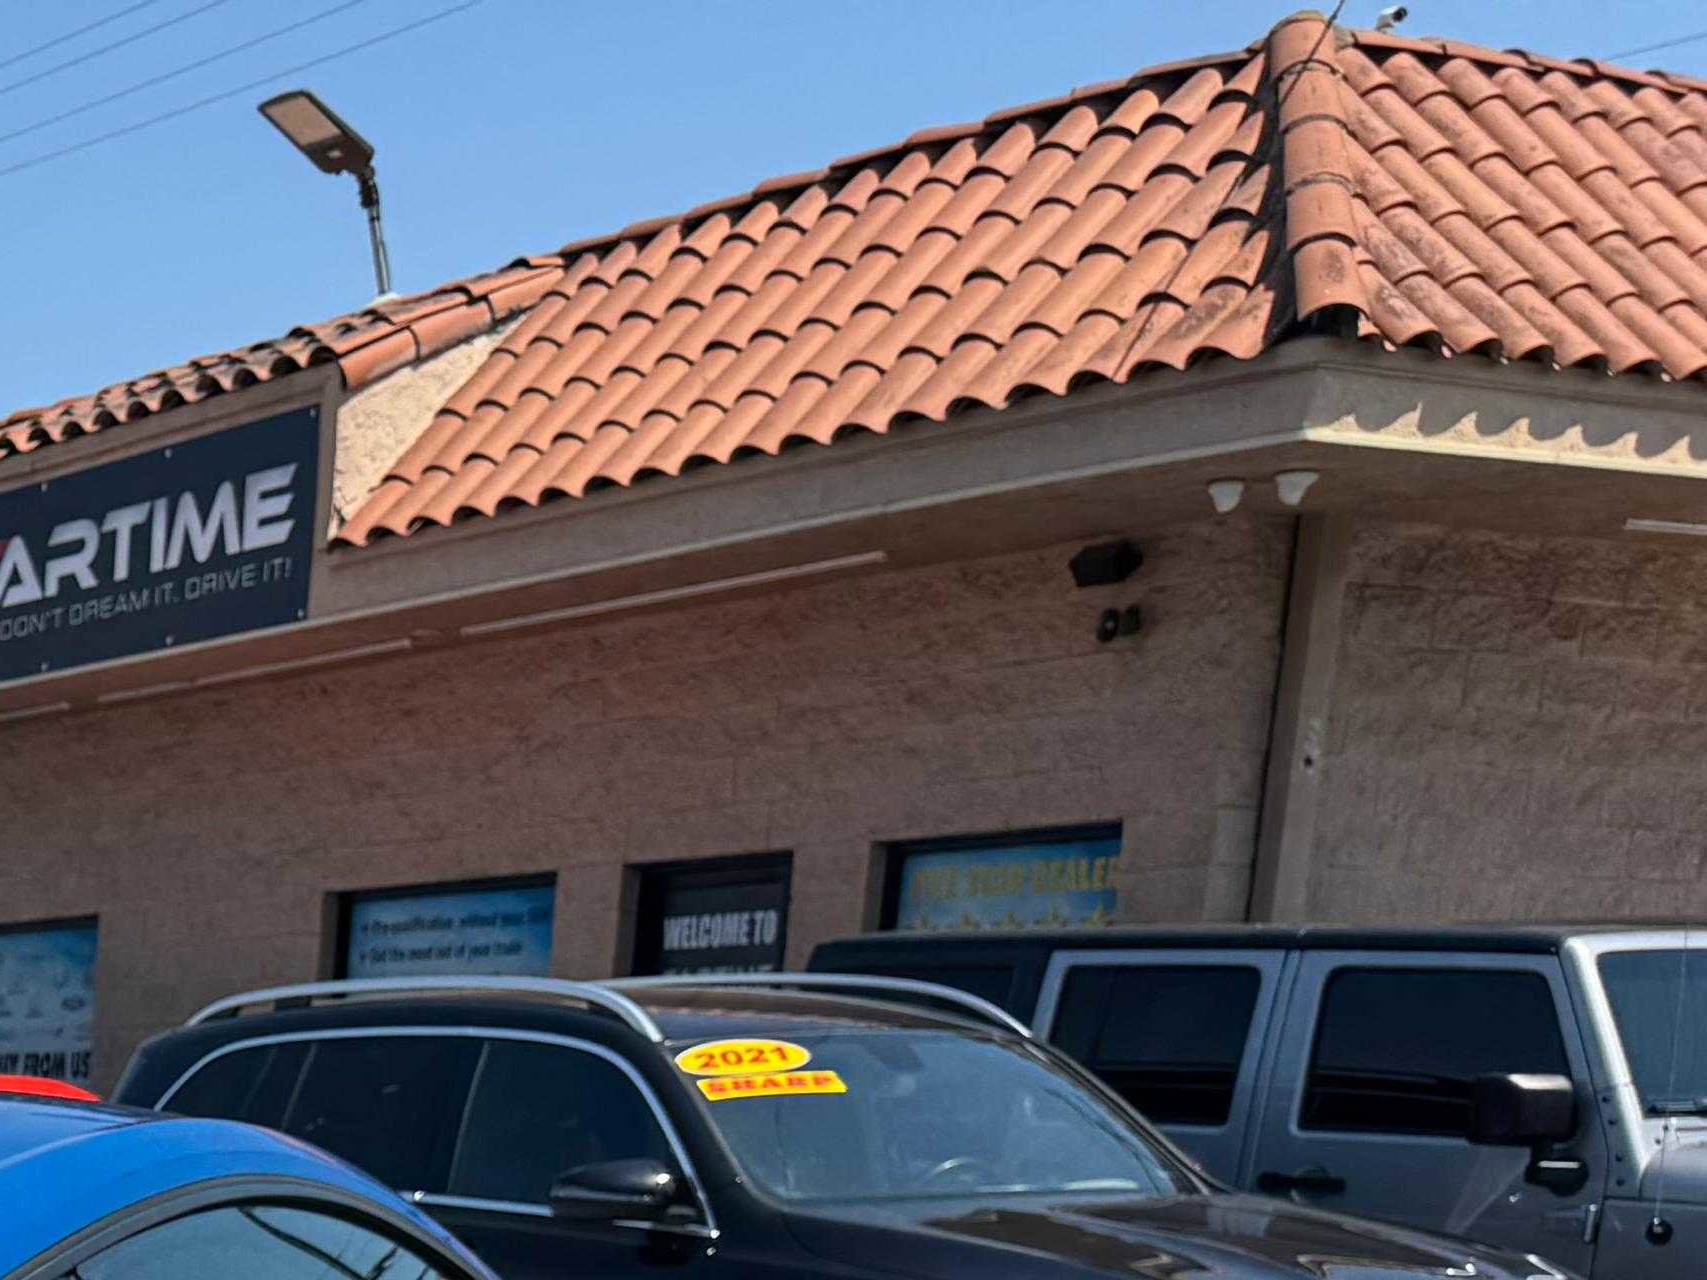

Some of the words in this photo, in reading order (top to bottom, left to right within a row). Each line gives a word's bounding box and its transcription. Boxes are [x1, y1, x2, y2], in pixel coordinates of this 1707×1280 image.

[69, 591, 150, 627] DREAM
[154, 584, 180, 608] IT.
[185, 562, 260, 600] DRIVE
[263, 557, 292, 583] IT!
[664, 913, 749, 950] WELCOME
[753, 909, 778, 945] TO
[23, 1053, 65, 1078] FROM
[70, 1052, 91, 1078] US
[696, 1046, 789, 1070] 2021
[708, 1076, 832, 1093] SHARP
